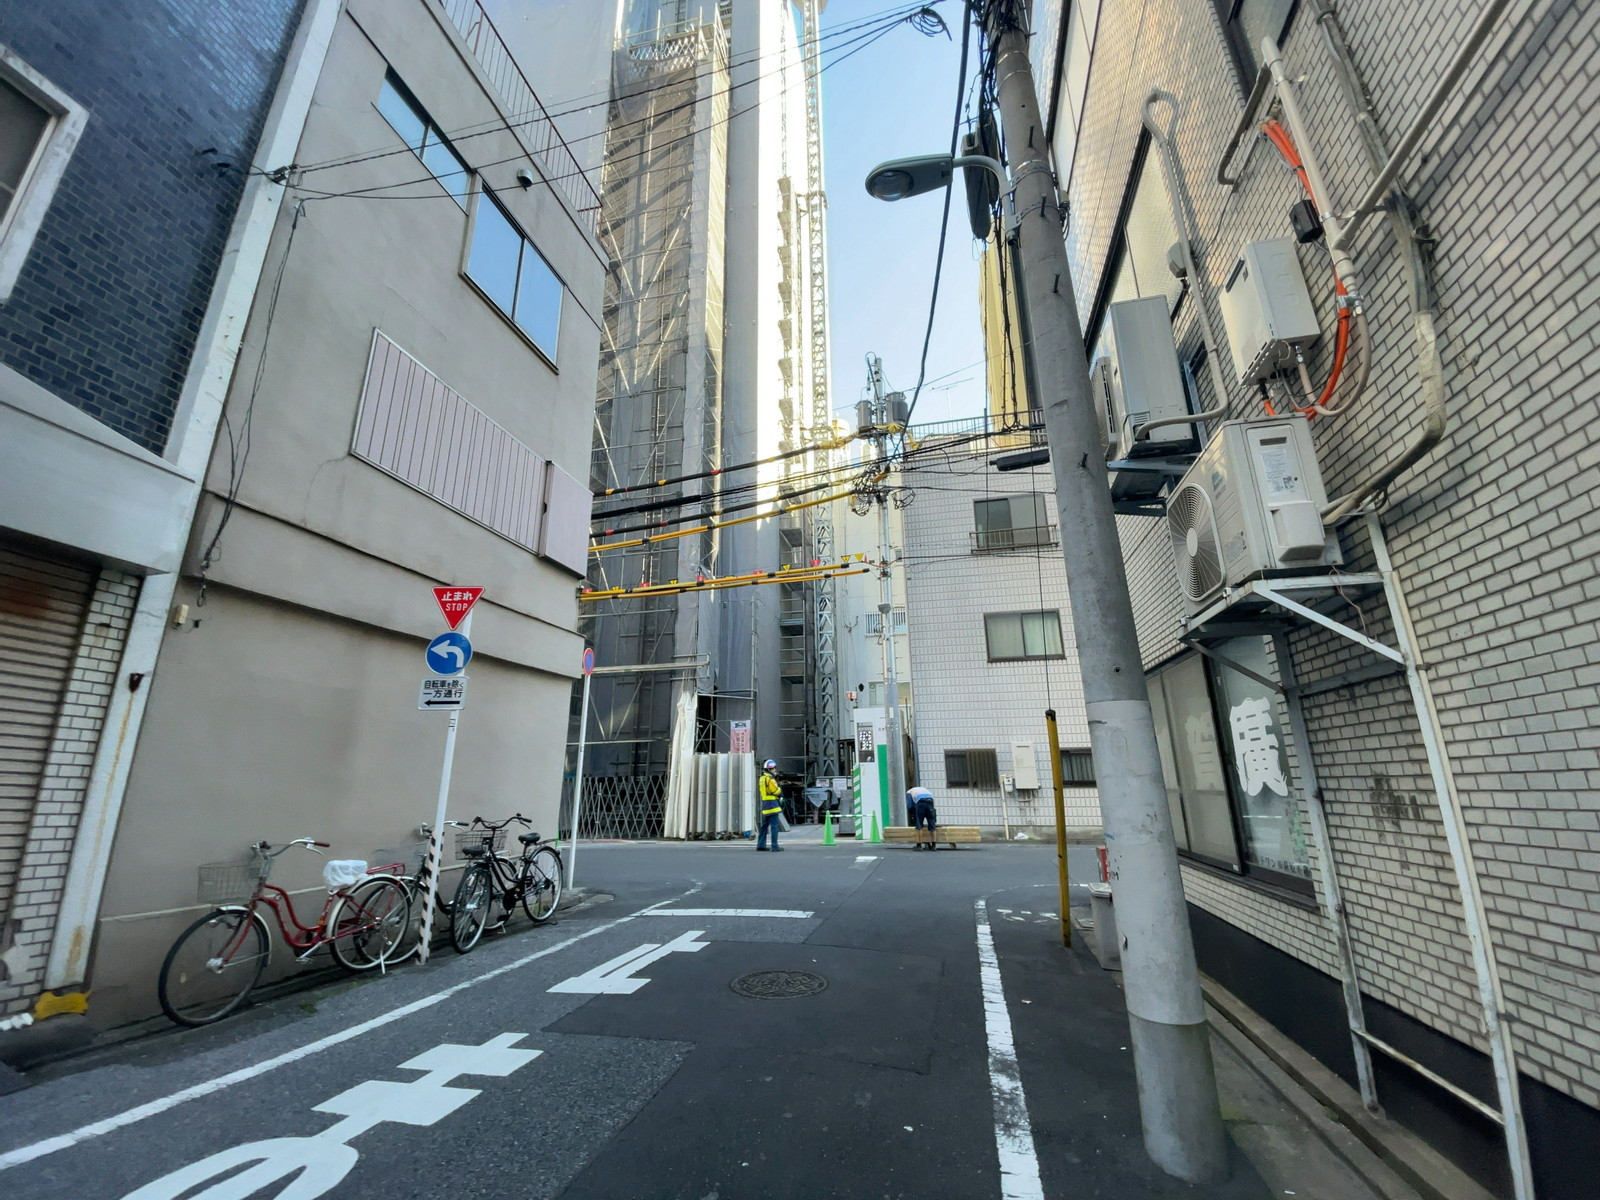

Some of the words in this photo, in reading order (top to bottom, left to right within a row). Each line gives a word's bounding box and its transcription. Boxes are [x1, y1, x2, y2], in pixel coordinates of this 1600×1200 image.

[441, 591, 474, 601] 止まれ
[445, 602, 468, 611] STOP
[424, 680, 464, 690] 自転車を除く
[423, 690, 463, 698] 一方通行
